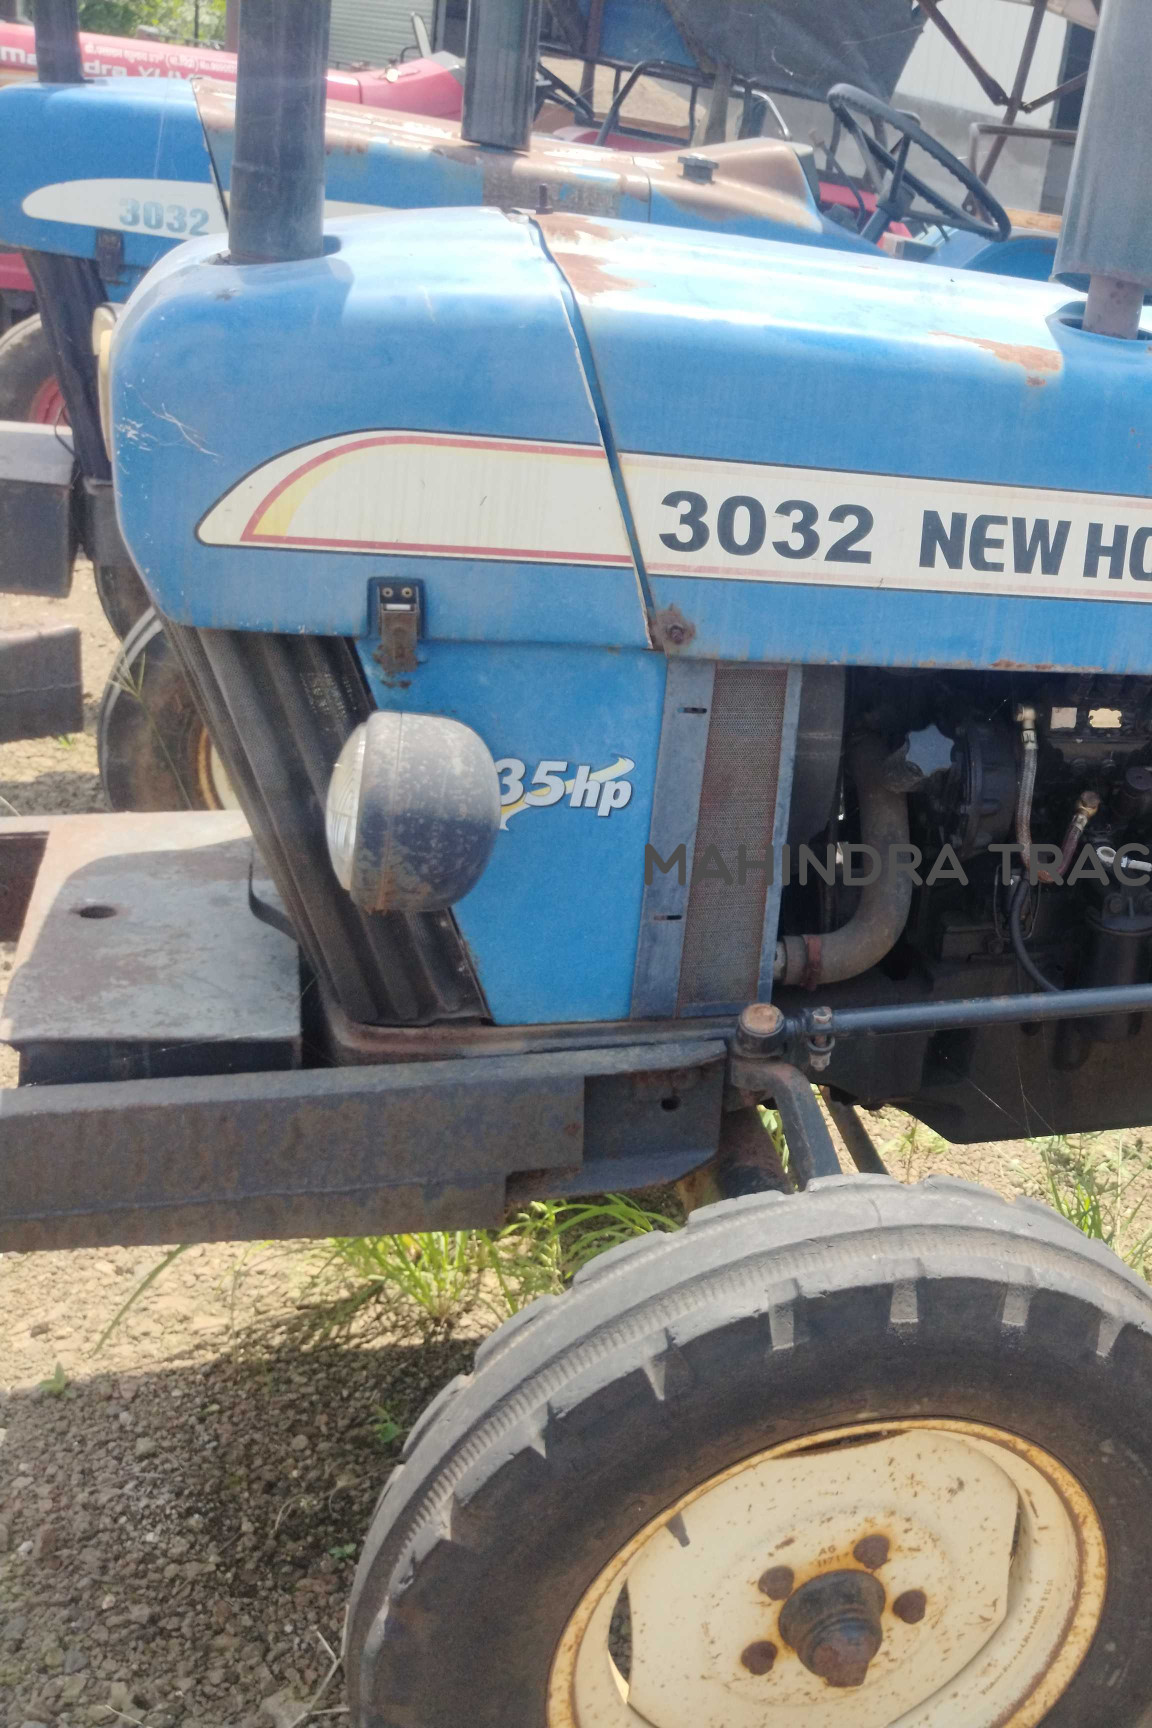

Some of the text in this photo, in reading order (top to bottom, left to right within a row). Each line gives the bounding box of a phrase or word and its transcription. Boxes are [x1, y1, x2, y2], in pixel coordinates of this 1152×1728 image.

[119, 198, 209, 236] 3032
[659, 491, 874, 564] 3032
[919, 510, 1071, 574] NEW
[495, 758, 632, 816] 35hp
